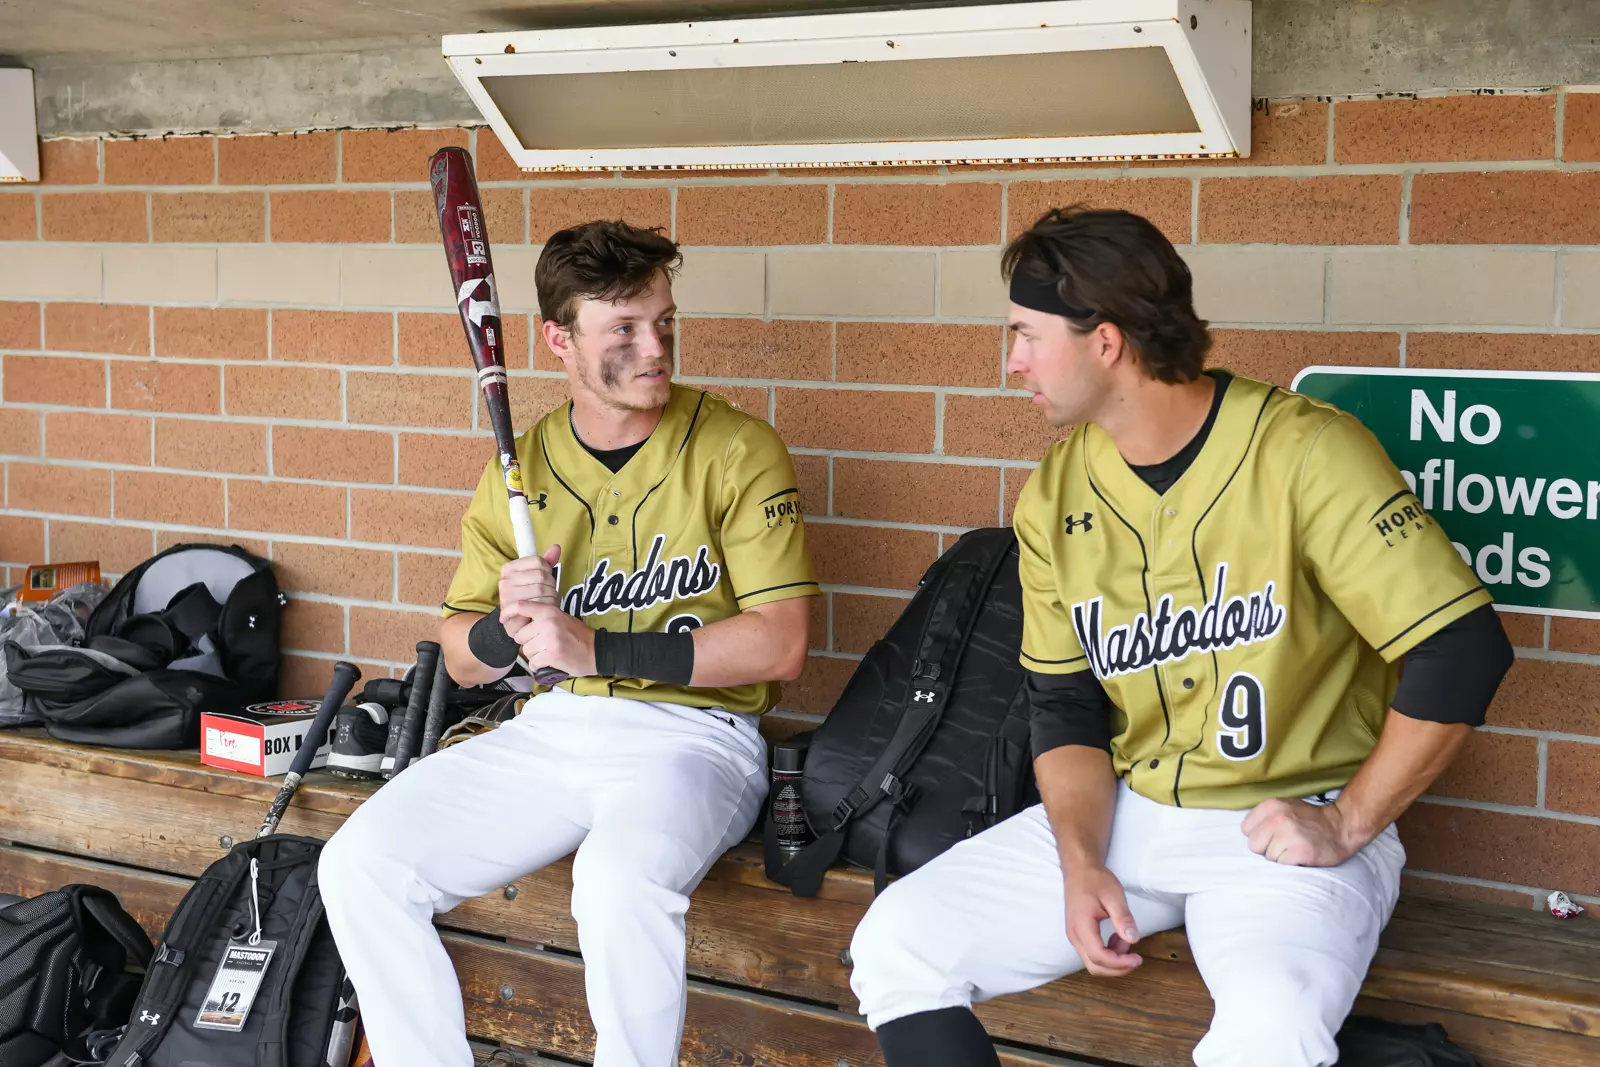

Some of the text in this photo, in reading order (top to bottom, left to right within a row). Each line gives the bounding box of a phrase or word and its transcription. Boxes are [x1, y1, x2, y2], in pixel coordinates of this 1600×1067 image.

[1409, 388, 1502, 445] No
[767, 516, 799, 529] LEA
[1071, 562, 1287, 681] Mastodons
[1216, 671, 1267, 762] 9
[264, 736, 291, 756] BOX
[229, 950, 266, 962] MASTODON
[217, 991, 242, 1014] 12
